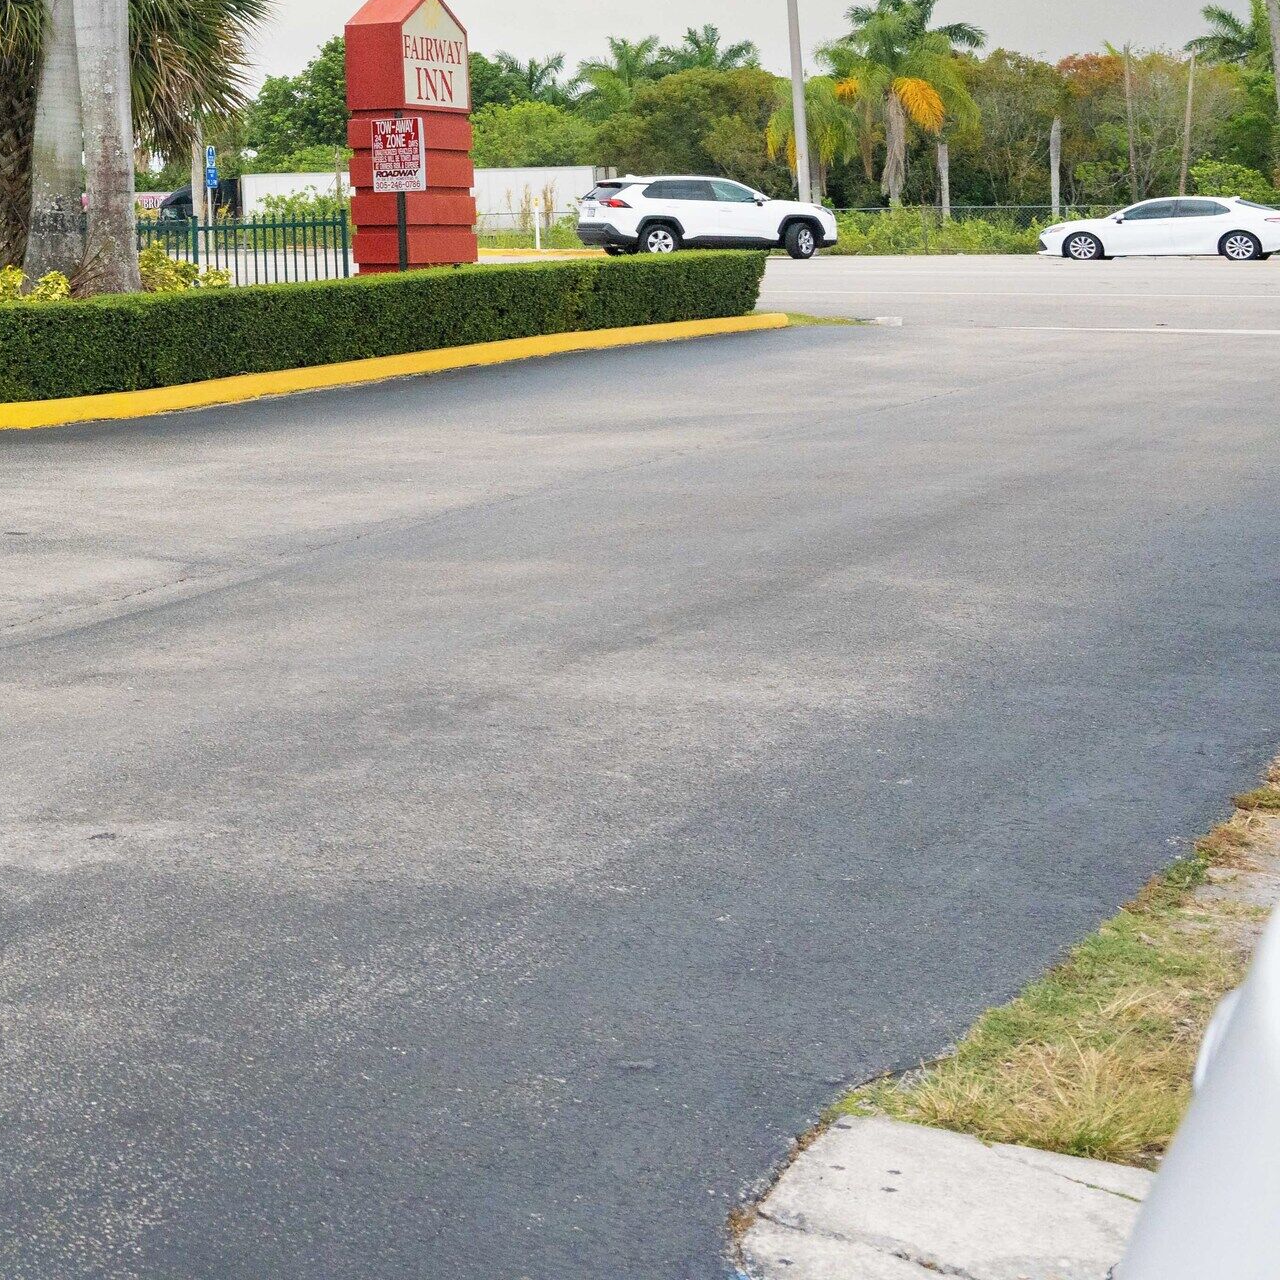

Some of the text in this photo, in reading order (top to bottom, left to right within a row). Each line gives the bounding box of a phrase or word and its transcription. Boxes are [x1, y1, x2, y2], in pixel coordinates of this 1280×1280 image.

[403, 34, 463, 65] FAIRWAY
[416, 67, 453, 103] INN
[376, 120, 413, 134] TOW-AWAY
[386, 133, 406, 148] ZONE
